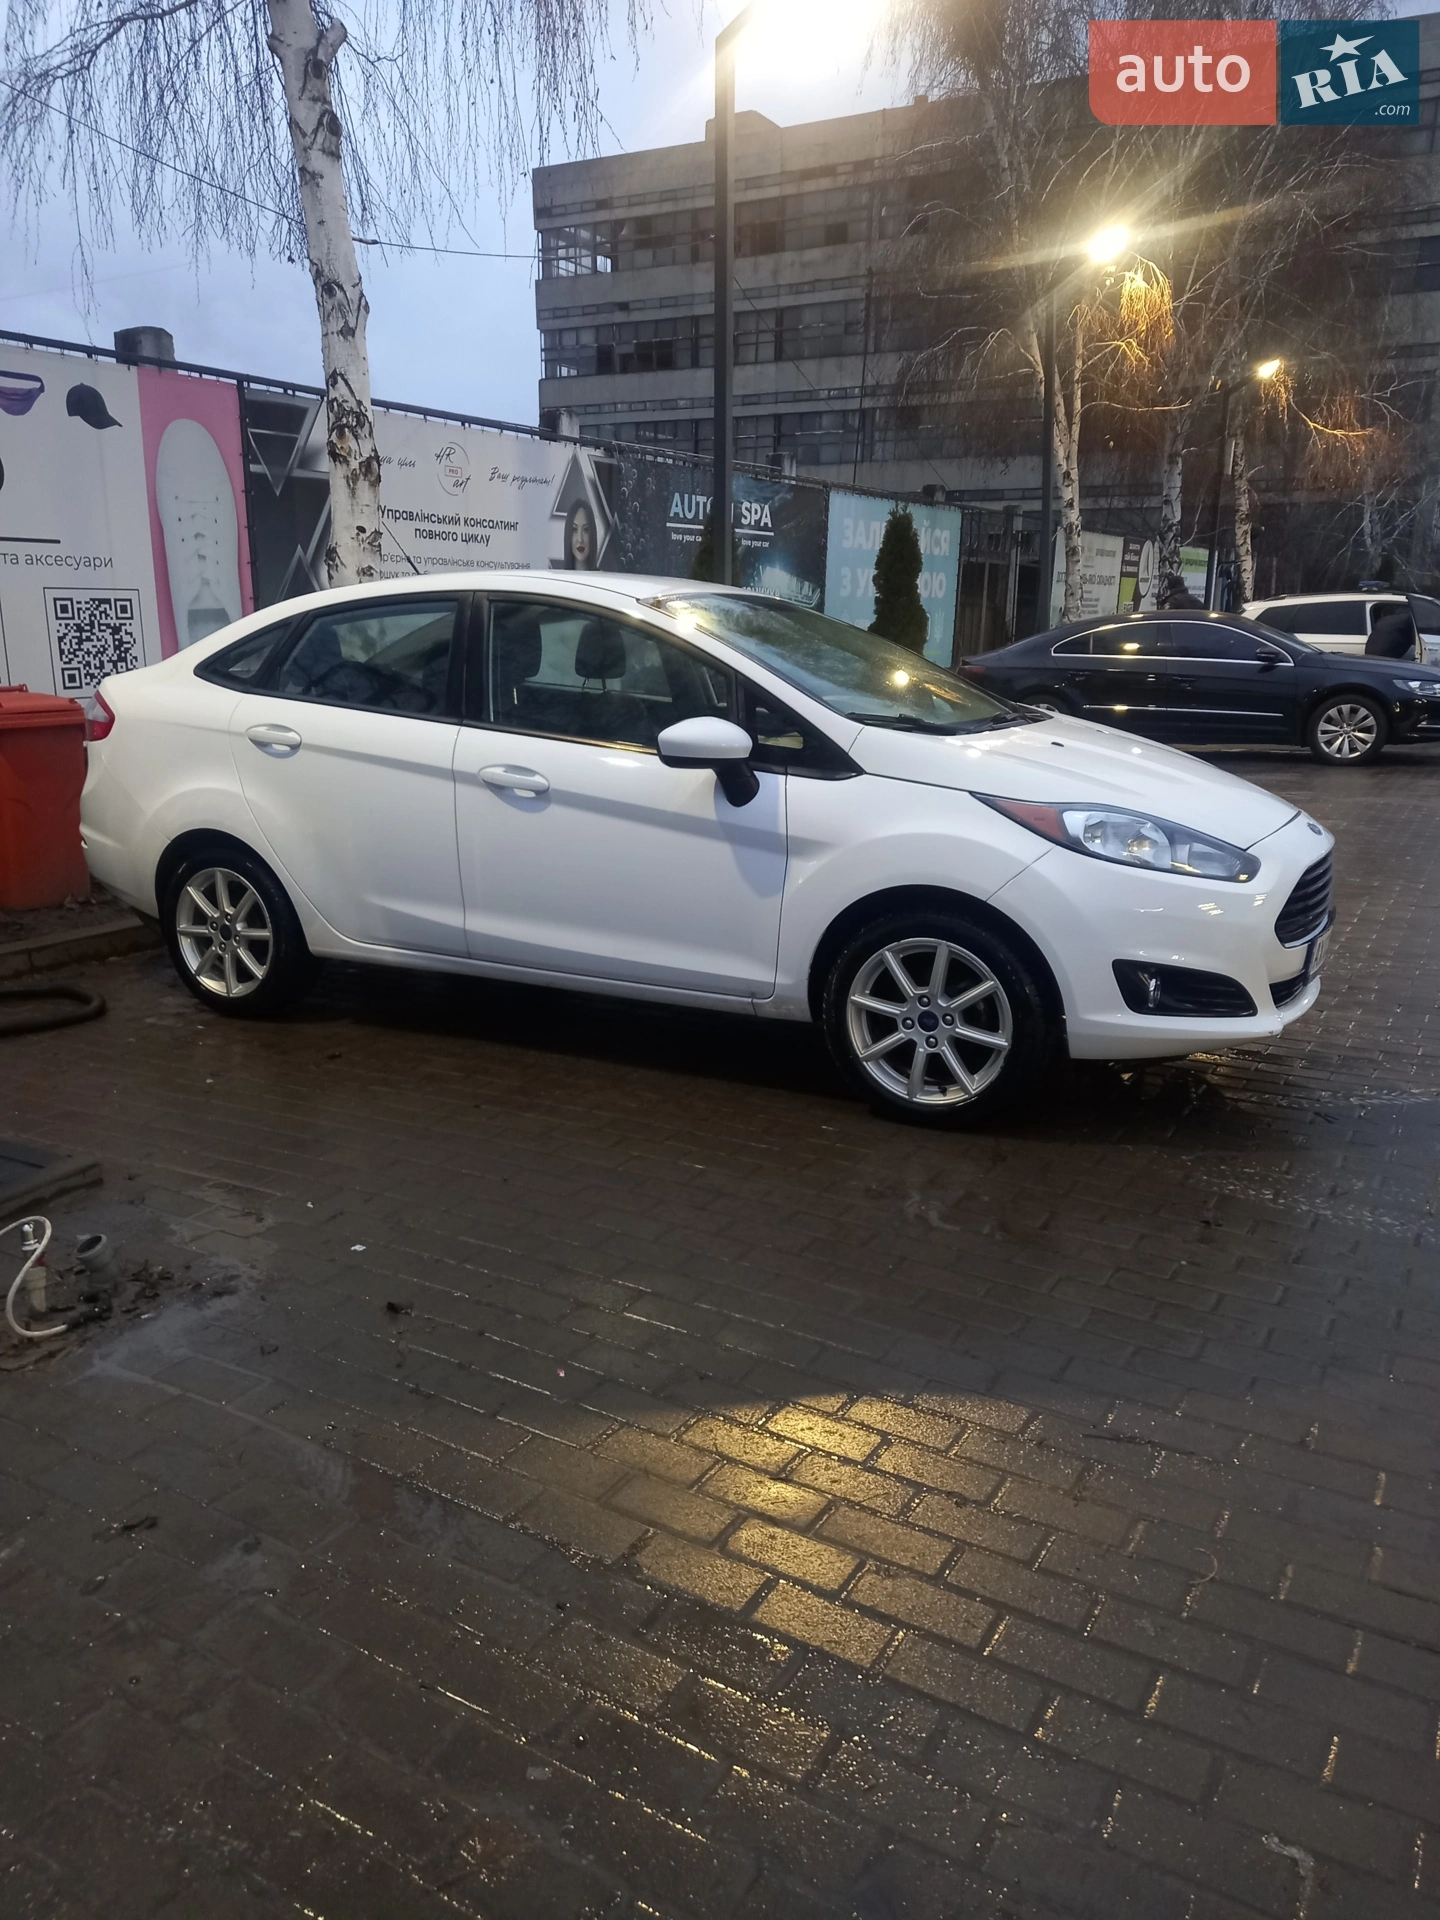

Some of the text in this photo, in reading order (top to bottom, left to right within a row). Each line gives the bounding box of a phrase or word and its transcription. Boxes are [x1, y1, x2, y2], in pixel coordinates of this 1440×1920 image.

[434, 446, 456, 464] HR
[448, 468, 459, 476] PRO
[379, 504, 519, 531] Управлінський консалтинг
[741, 501, 772, 527] SPA
[414, 528, 491, 547] повного циклу
[671, 532, 682, 541] love
[683, 533, 695, 544] your
[741, 538, 751, 546] love
[751, 540, 762, 548] your
[0, 552, 114, 571] та аксесуари
[424, 556, 475, 567] управлінське
